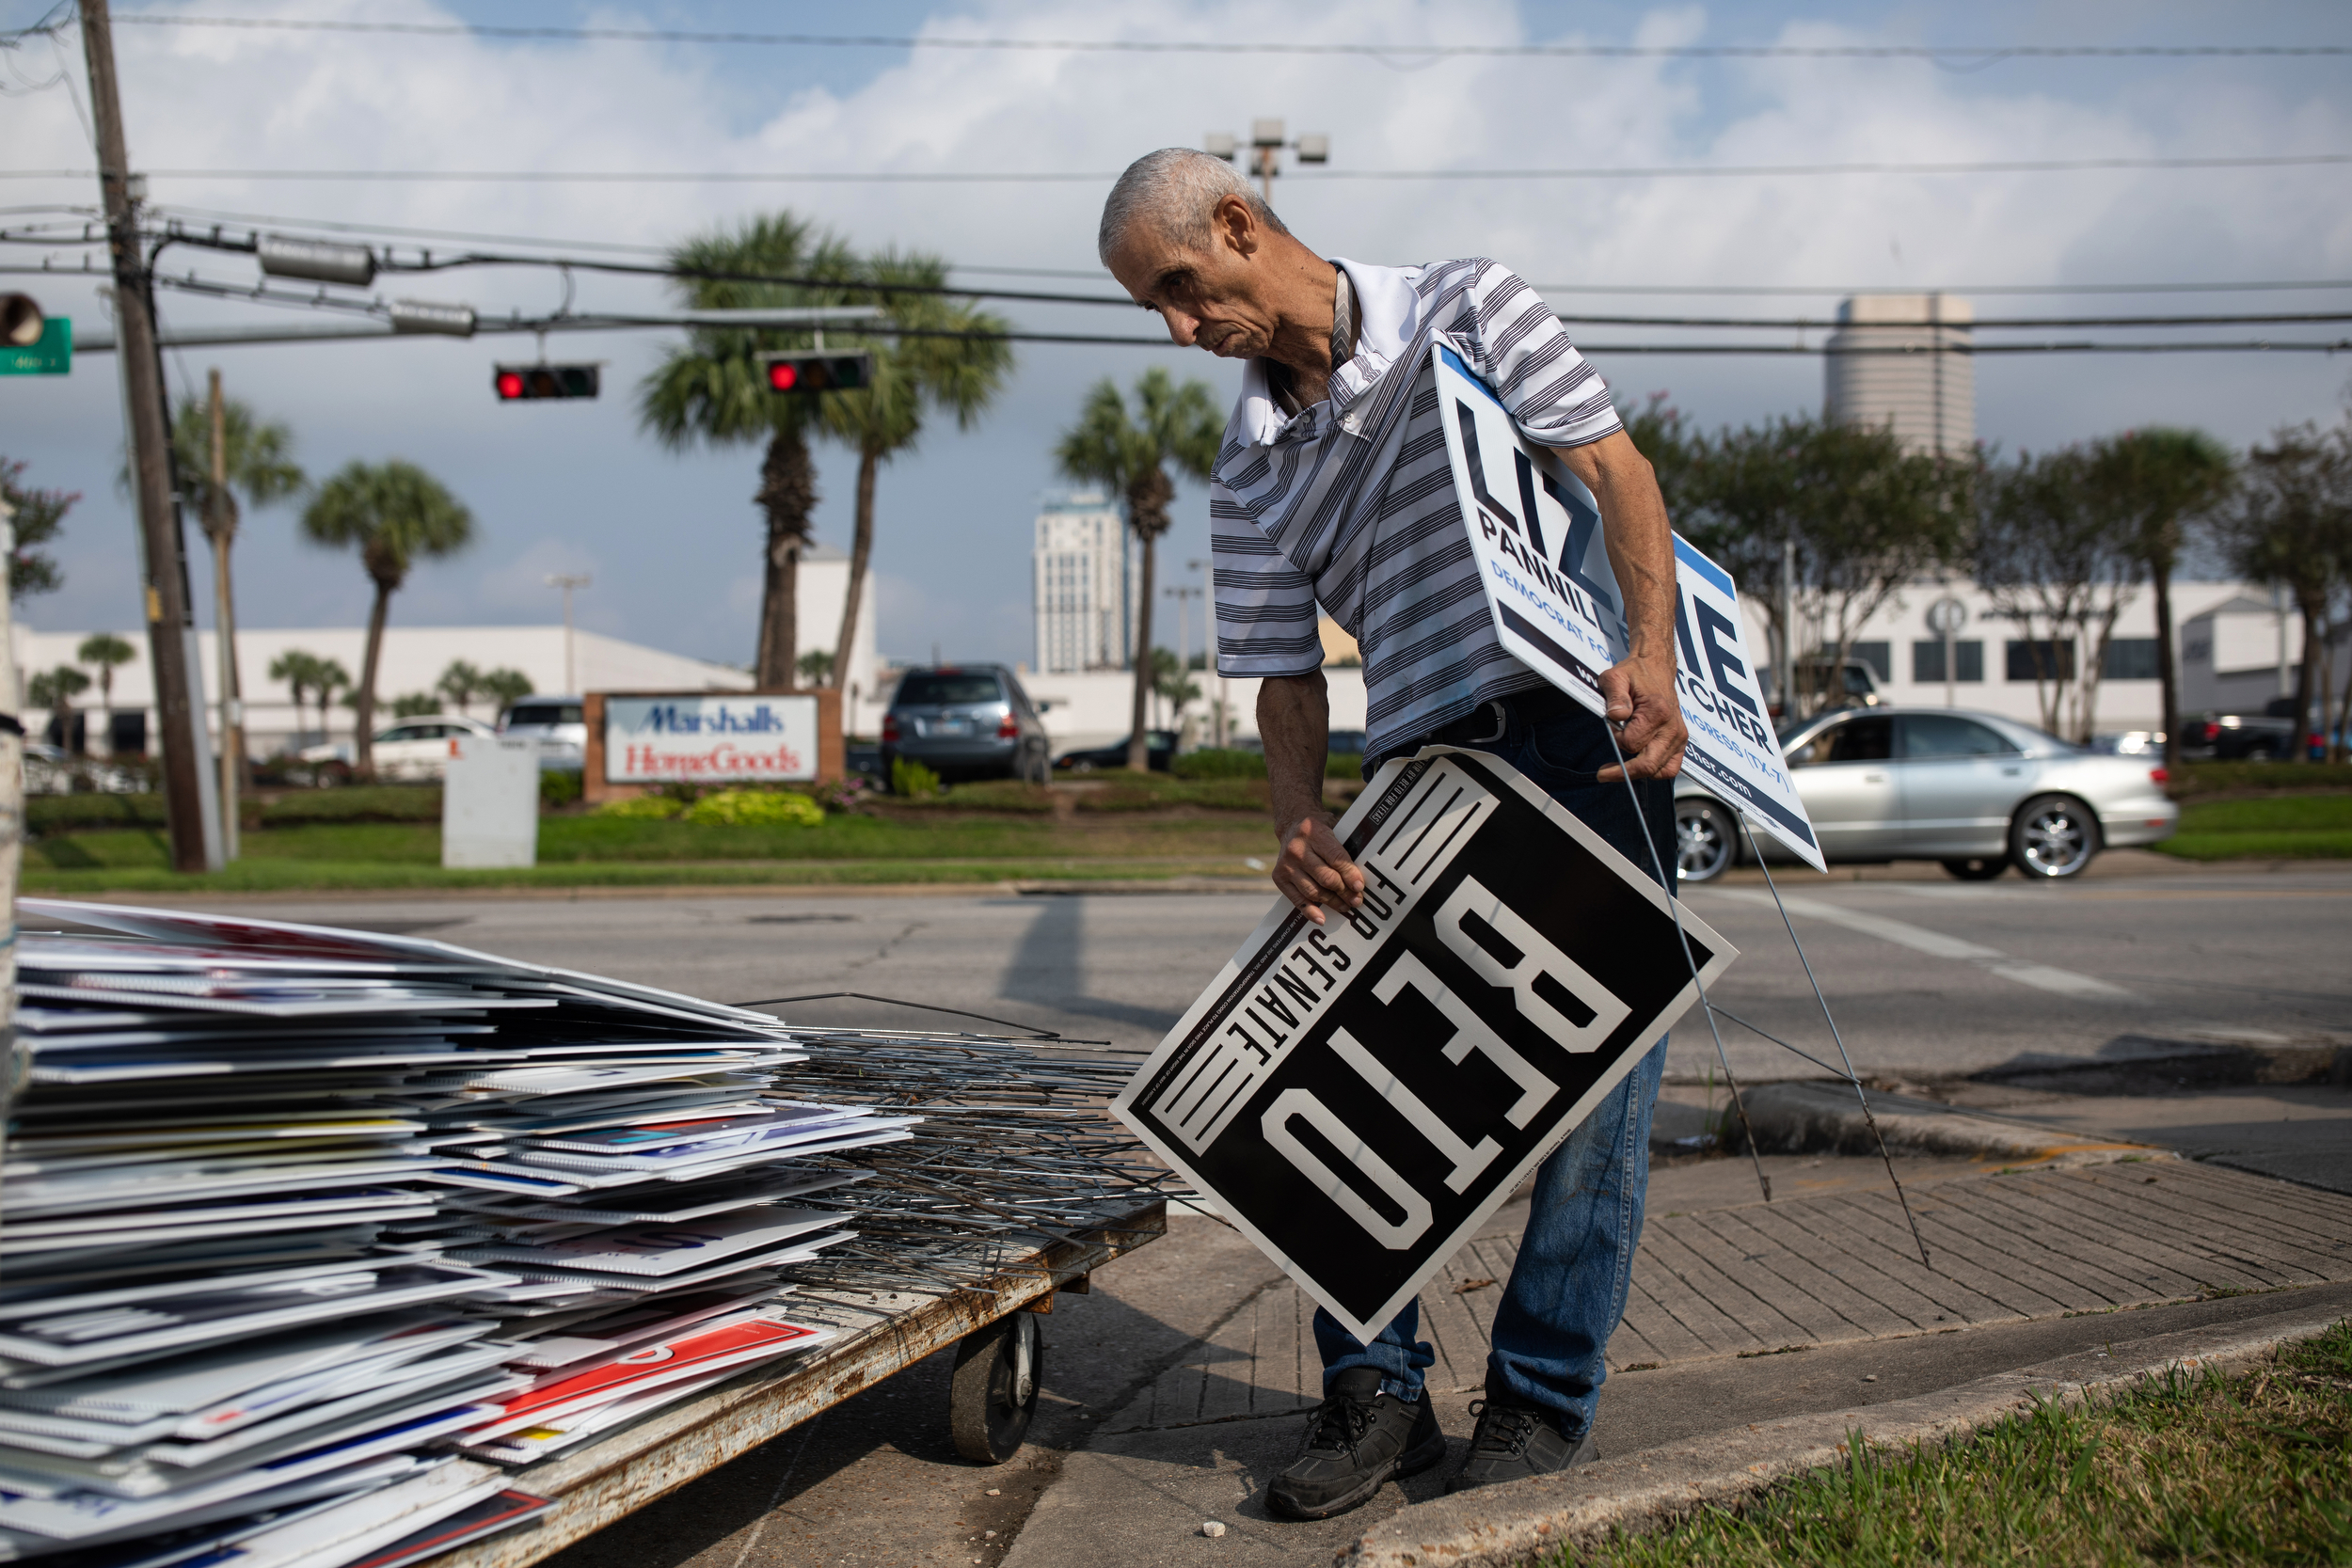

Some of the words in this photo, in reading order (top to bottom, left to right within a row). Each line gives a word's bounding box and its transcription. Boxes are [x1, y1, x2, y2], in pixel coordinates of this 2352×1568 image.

[1455, 397, 1760, 719] LIZIE
[1477, 507, 1614, 641] PANNILL
[1616, 621, 1774, 757] FTCHER
[1491, 559, 1584, 642] DEMOCRAT
[1743, 748, 1790, 794] (TX-7)
[636, 704, 785, 735] Marshalls
[625, 742, 801, 775] HomeGoods
[1685, 743, 1753, 799] cher.com
[1393, 778, 1409, 795] BETO
[1406, 770, 1416, 781] BY
[1372, 803, 1389, 823] TEXAS
[1385, 794, 1398, 806] FOR
[1339, 861, 1407, 941] FOR
[1260, 953, 1268, 963] AND
[1226, 970, 1255, 1003] TRANSPORTATION
[1226, 928, 1351, 1067] SENATE
[1194, 1031, 1203, 1040] THIS
[1201, 1018, 1214, 1032] PLACE
[1177, 1053, 1185, 1061] THE
[1186, 1038, 1197, 1050] SIGN
[1261, 874, 1632, 1250] BETO
